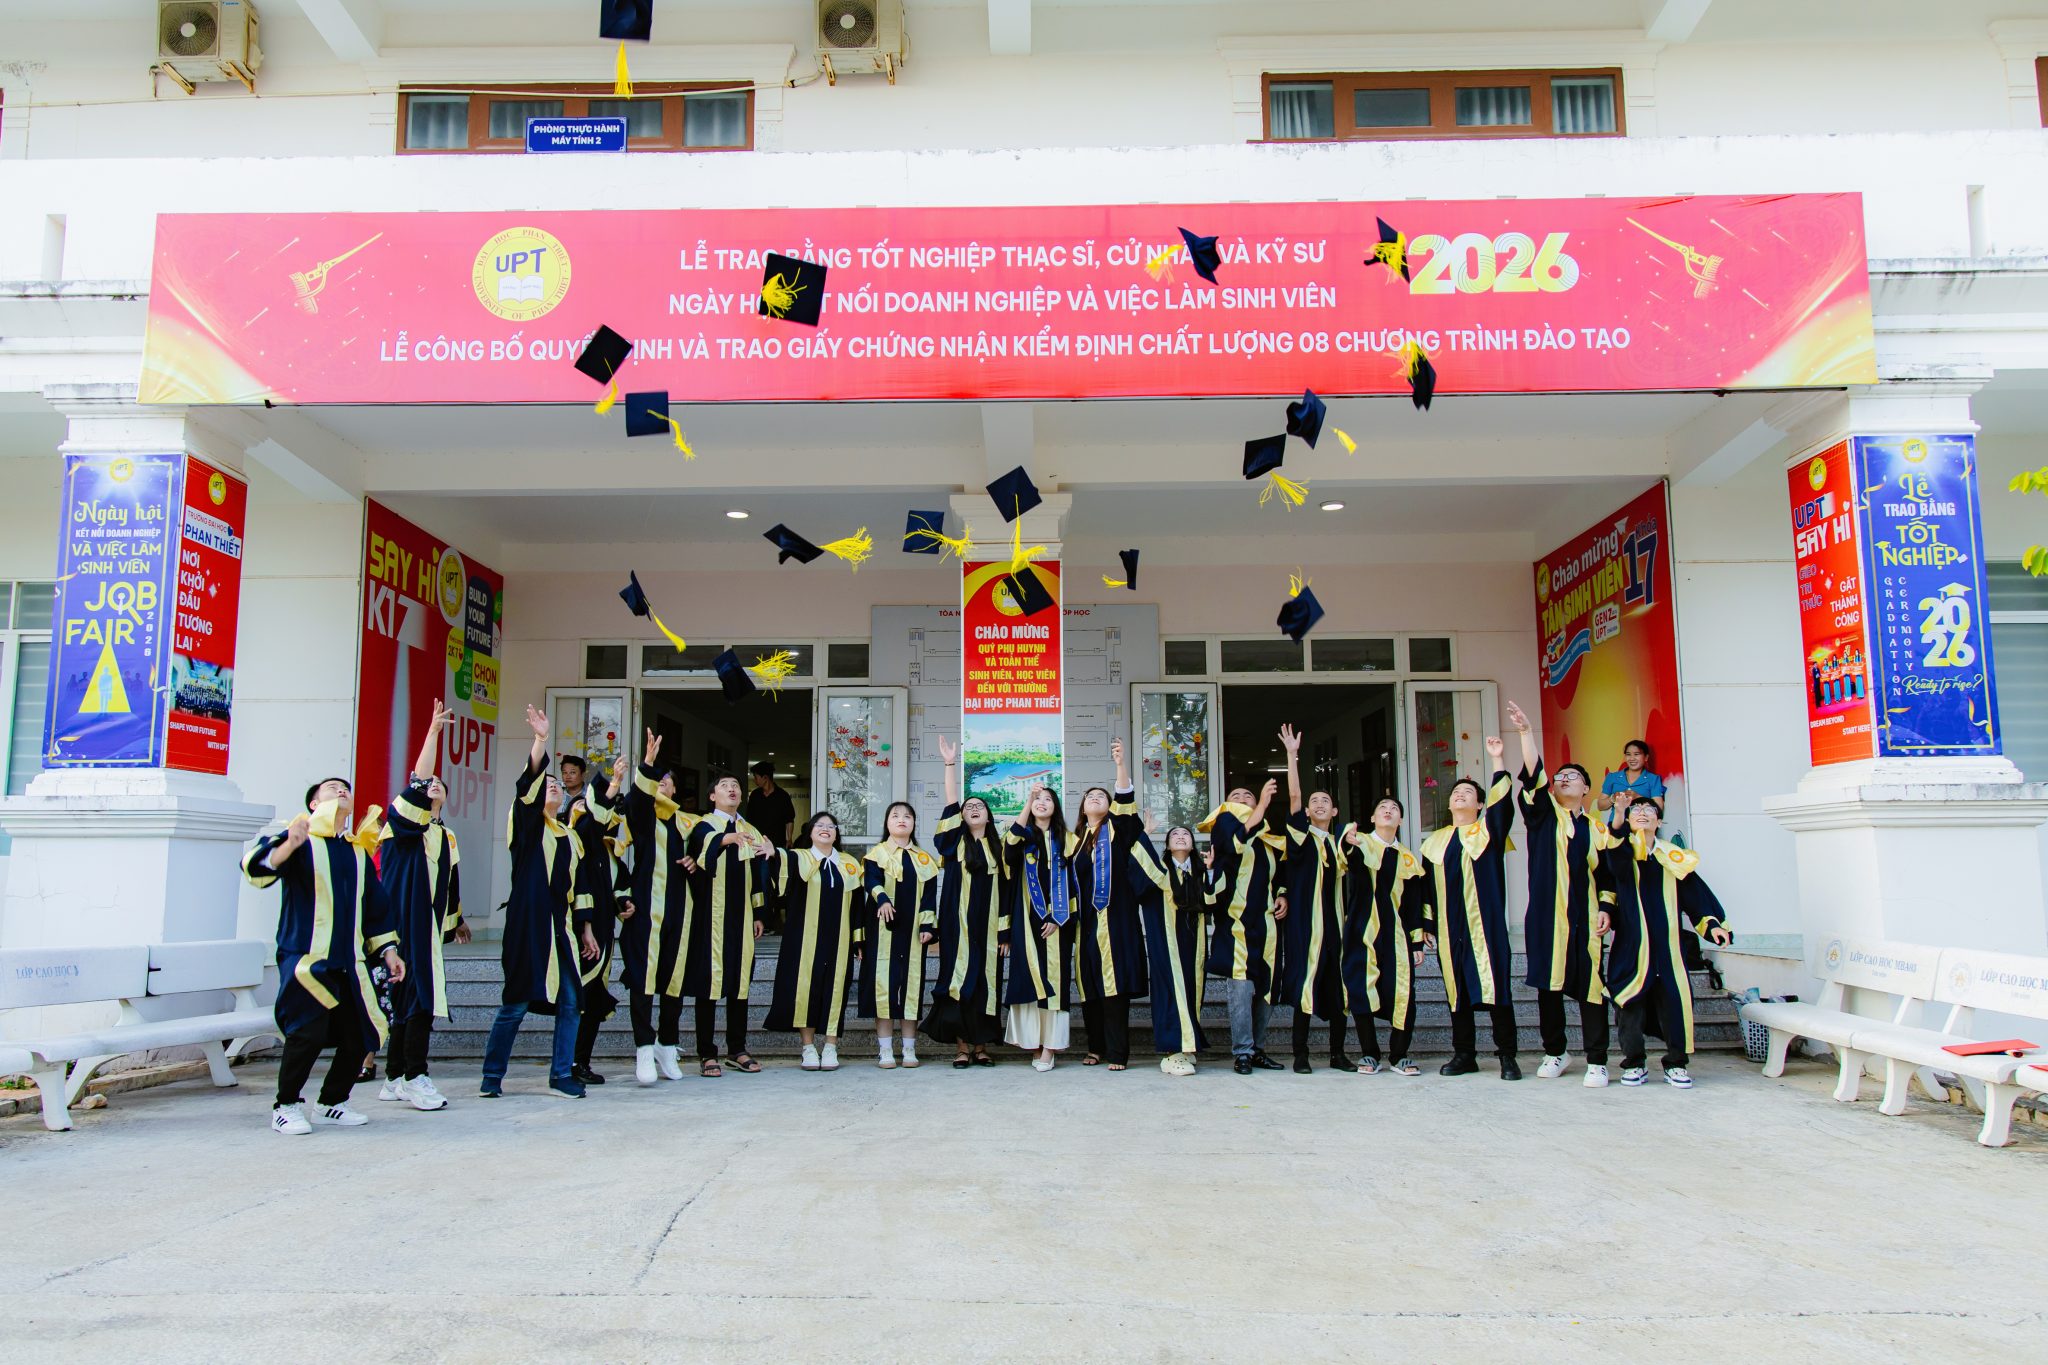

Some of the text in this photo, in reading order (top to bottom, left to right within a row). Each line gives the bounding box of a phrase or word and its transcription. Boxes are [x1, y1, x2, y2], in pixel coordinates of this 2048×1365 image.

[534, 124, 620, 134] PHÒNG THỰC HÀNH
[552, 136, 570, 145] MÁY
[572, 135, 594, 145] TÍNH
[496, 248, 546, 273] UPT
[680, 240, 708, 270] LỄ
[858, 238, 904, 268] TỐT
[910, 242, 996, 274] NGHIỆP
[1002, 246, 1066, 273] THẠC
[1072, 240, 1100, 268] SĨ,
[1106, 238, 1142, 266] CỬ
[1218, 237, 1250, 264] VÀ
[1257, 237, 1288, 264] KỸ
[1294, 240, 1325, 263] SƯ
[1409, 232, 1579, 294] 2026
[669, 288, 734, 315] NGÀY
[838, 282, 878, 313] NỐI
[885, 291, 968, 314] DOANH
[975, 286, 1061, 317] NGHIỆP
[1068, 282, 1098, 311] VÀ
[1104, 284, 1159, 316] VIỆC
[1165, 282, 1216, 310] LÀM
[1221, 288, 1276, 309] SINH
[1282, 281, 1336, 308] VIÊN
[380, 322, 1630, 366] LỄ CÔNG BỐ ỊNH VÀ TRAO GIẤY CHỨNG NHẬN KIỂM ĐỊNH CHẤT LƯỢNG 08 CHƯƠNG TRÌNH ĐÀO TẠO
[1898, 472, 1933, 503] Lễ
[74, 500, 164, 526] Ngày hội
[1794, 496, 1826, 530] UPT
[1883, 498, 1956, 517] TRAO BẰNG
[76, 527, 160, 539] KẾT NỐI DOANH NGHIỆP
[185, 523, 240, 556] PHAN THIẾT
[1796, 522, 1828, 559] SAY
[1896, 516, 1940, 544] TỐT
[72, 540, 161, 560] VÀ VIỆC LÀM
[182, 549, 200, 568] NƠI
[370, 530, 412, 592] SAY
[1552, 528, 1618, 592] Chào mừng
[1882, 542, 1959, 570] NGHIỆP
[81, 558, 150, 574] SINH VIÊN
[1622, 530, 1658, 607] 17
[1800, 564, 1817, 580] GIEO
[180, 570, 204, 592] KHỞI
[446, 572, 458, 588] UPT
[1800, 582, 1812, 596] TRI
[1840, 576, 1856, 594] GẶT
[84, 581, 158, 612] JOB
[468, 586, 487, 606] BUILD
[1542, 557, 1624, 640] TÂN SINH VIÊN
[1802, 593, 1822, 612] THỨC
[1830, 594, 1858, 612] THÀNH
[178, 612, 212, 636] TƯƠNG
[367, 579, 428, 650] K17
[468, 606, 486, 626] YOUR
[1074, 609, 1090, 617] HỌC
[1834, 611, 1860, 628] CÔNG
[1898, 576, 1914, 671] CEREMONY
[1918, 596, 1971, 634] 20
[65, 618, 135, 645] FAIR
[144, 611, 154, 656] 2026
[466, 626, 492, 648] FUTURE
[975, 623, 1050, 639] CHÀO MỪNG
[1596, 626, 1606, 640] UPT
[1884, 577, 1902, 696] GRADUATION
[176, 634, 192, 651] LAI
[978, 642, 1046, 654] QUÝ PHỤ HUYNH
[1921, 630, 1976, 668] 26
[986, 656, 996, 666] VÀ
[998, 656, 1022, 666] TOÀN
[474, 663, 496, 687] CHỌN
[969, 669, 1056, 681] SINH VIÊN, HỌC VIÊN
[1902, 674, 1938, 696] Ready
[978, 681, 1048, 693] ĐẾN VỚI TRƯỜNG
[966, 694, 1060, 711] ĐẠI HỌC PHAN THIẾT
[170, 722, 216, 736] SHAPE YOUR FUTURE
[1810, 715, 1844, 728] DREAM BEYOND
[1842, 724, 1872, 735] START HERE
[208, 741, 228, 751] WITH UPT
[448, 713, 495, 772] UPT
[447, 766, 493, 821] UPT
